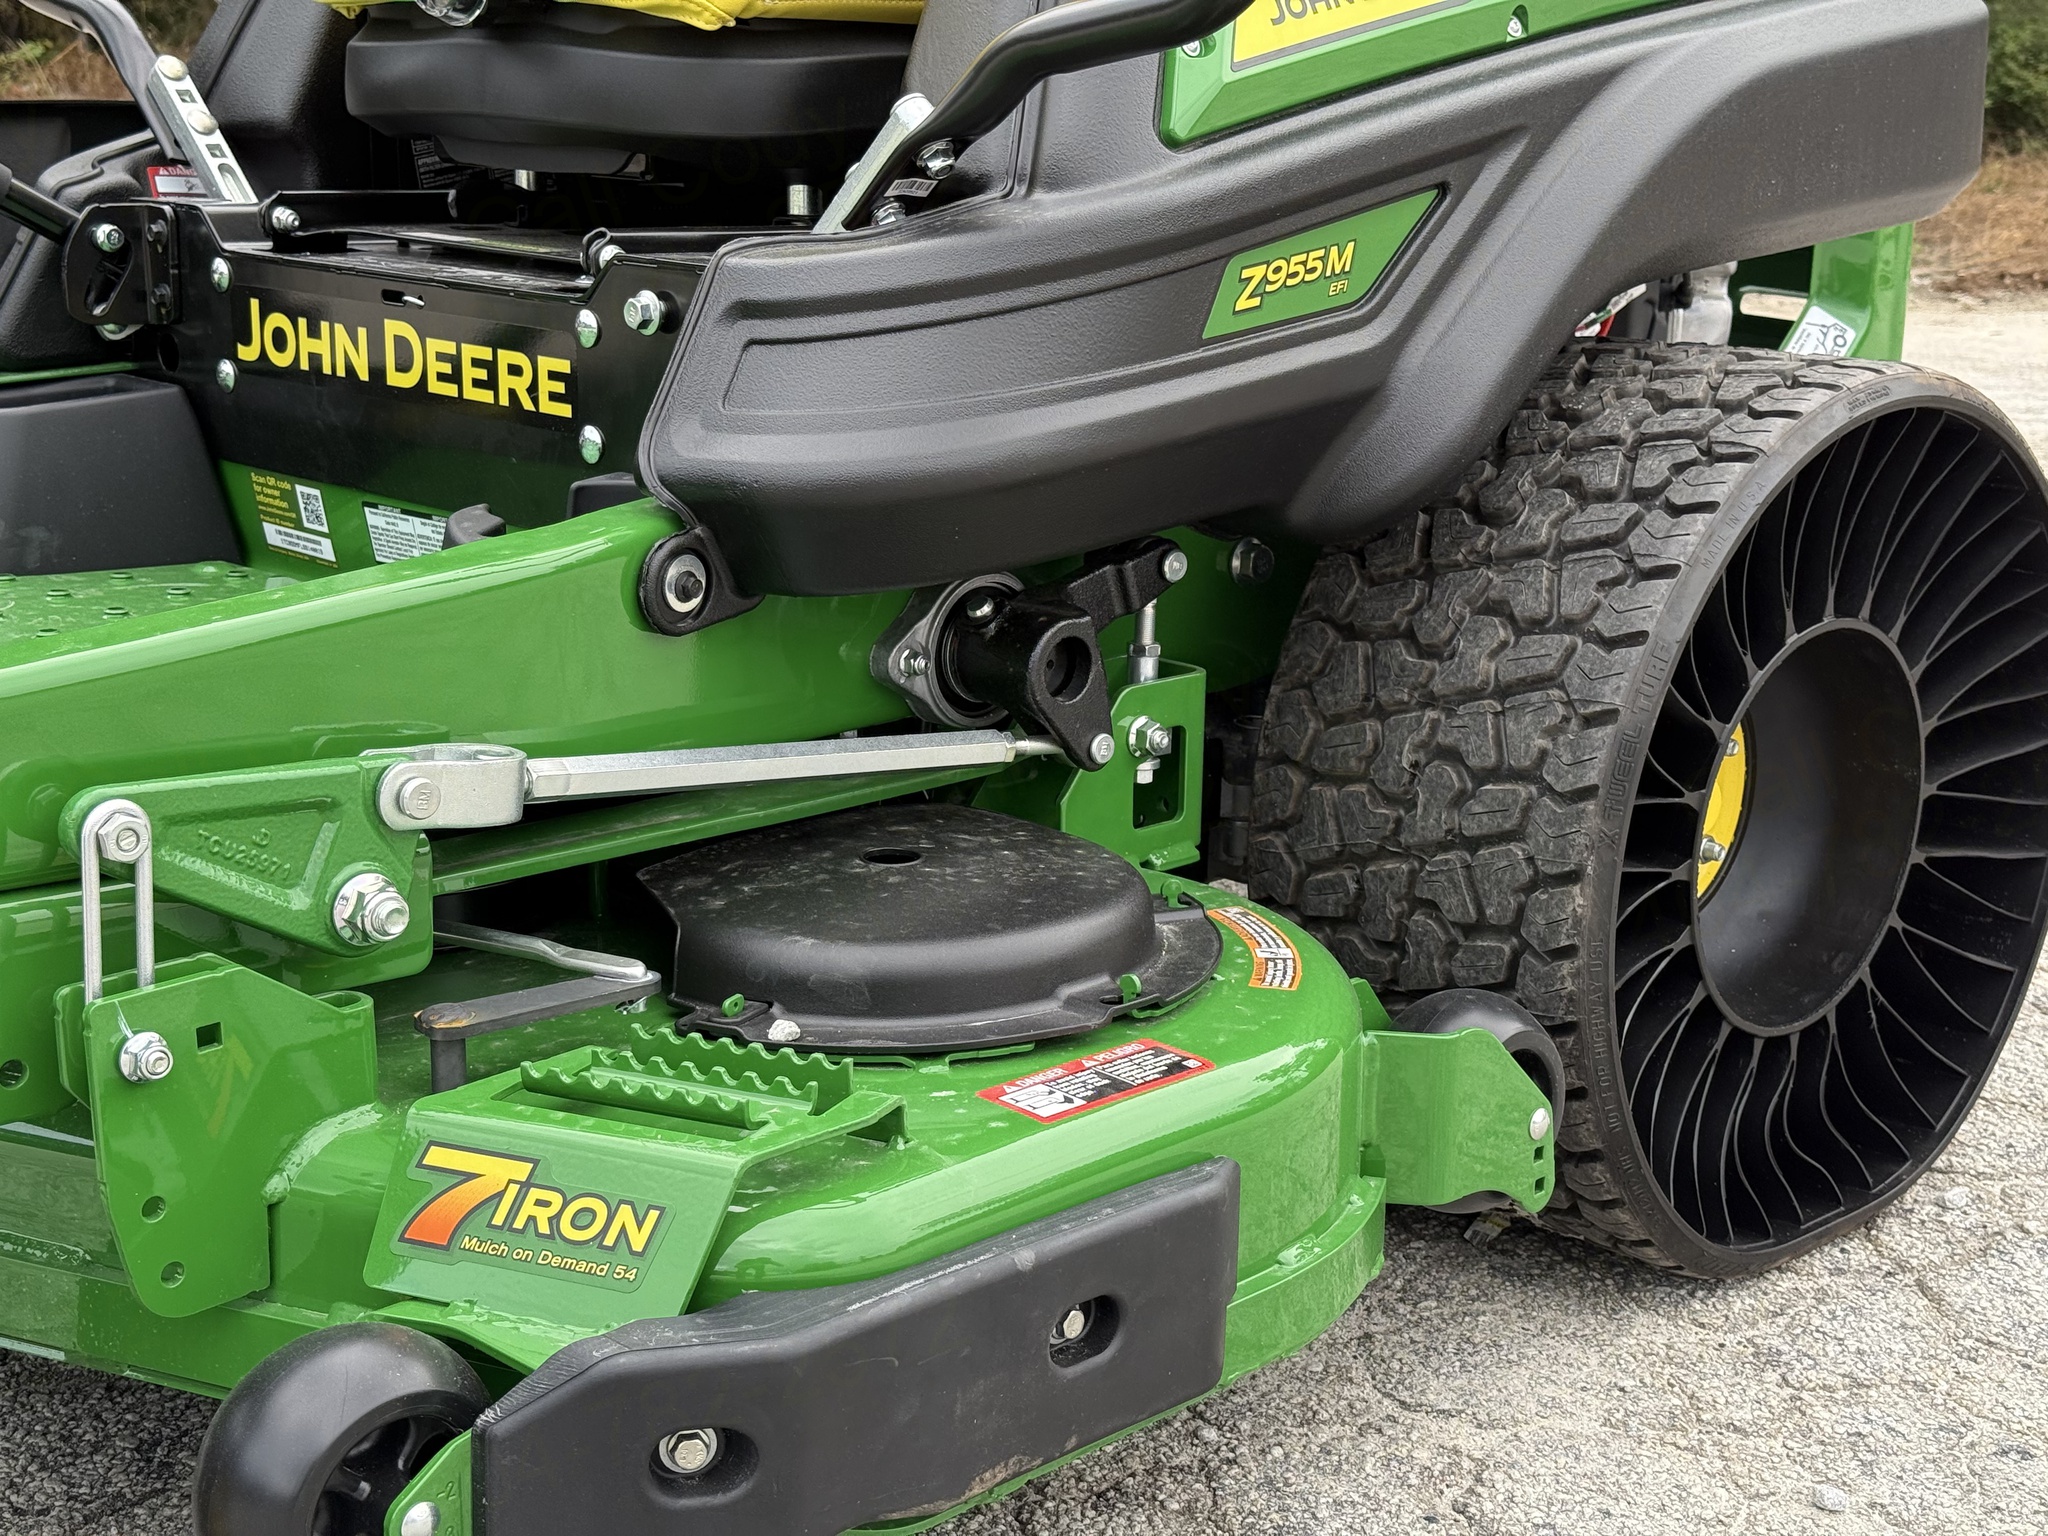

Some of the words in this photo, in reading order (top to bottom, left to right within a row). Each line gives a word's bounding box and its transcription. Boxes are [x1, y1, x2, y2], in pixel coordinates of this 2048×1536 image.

[1233, 239, 1356, 314] Z955M
[1328, 279, 1349, 297] EFI
[237, 297, 369, 382] JOHN
[384, 318, 572, 418] DEERE
[251, 472, 266, 484] Scan
[266, 475, 276, 487] QR
[276, 480, 292, 491] code
[1603, 723, 1645, 821] TWEEL
[1093, 1043, 1146, 1062] PELIGRO
[1015, 1067, 1069, 1088] DANGER
[398, 1140, 541, 1250] 7
[486, 1179, 667, 1257] IRON
[460, 1235, 509, 1258] Mulch
[512, 1246, 534, 1264] on
[536, 1250, 611, 1277] Demand
[612, 1265, 639, 1283] 54
